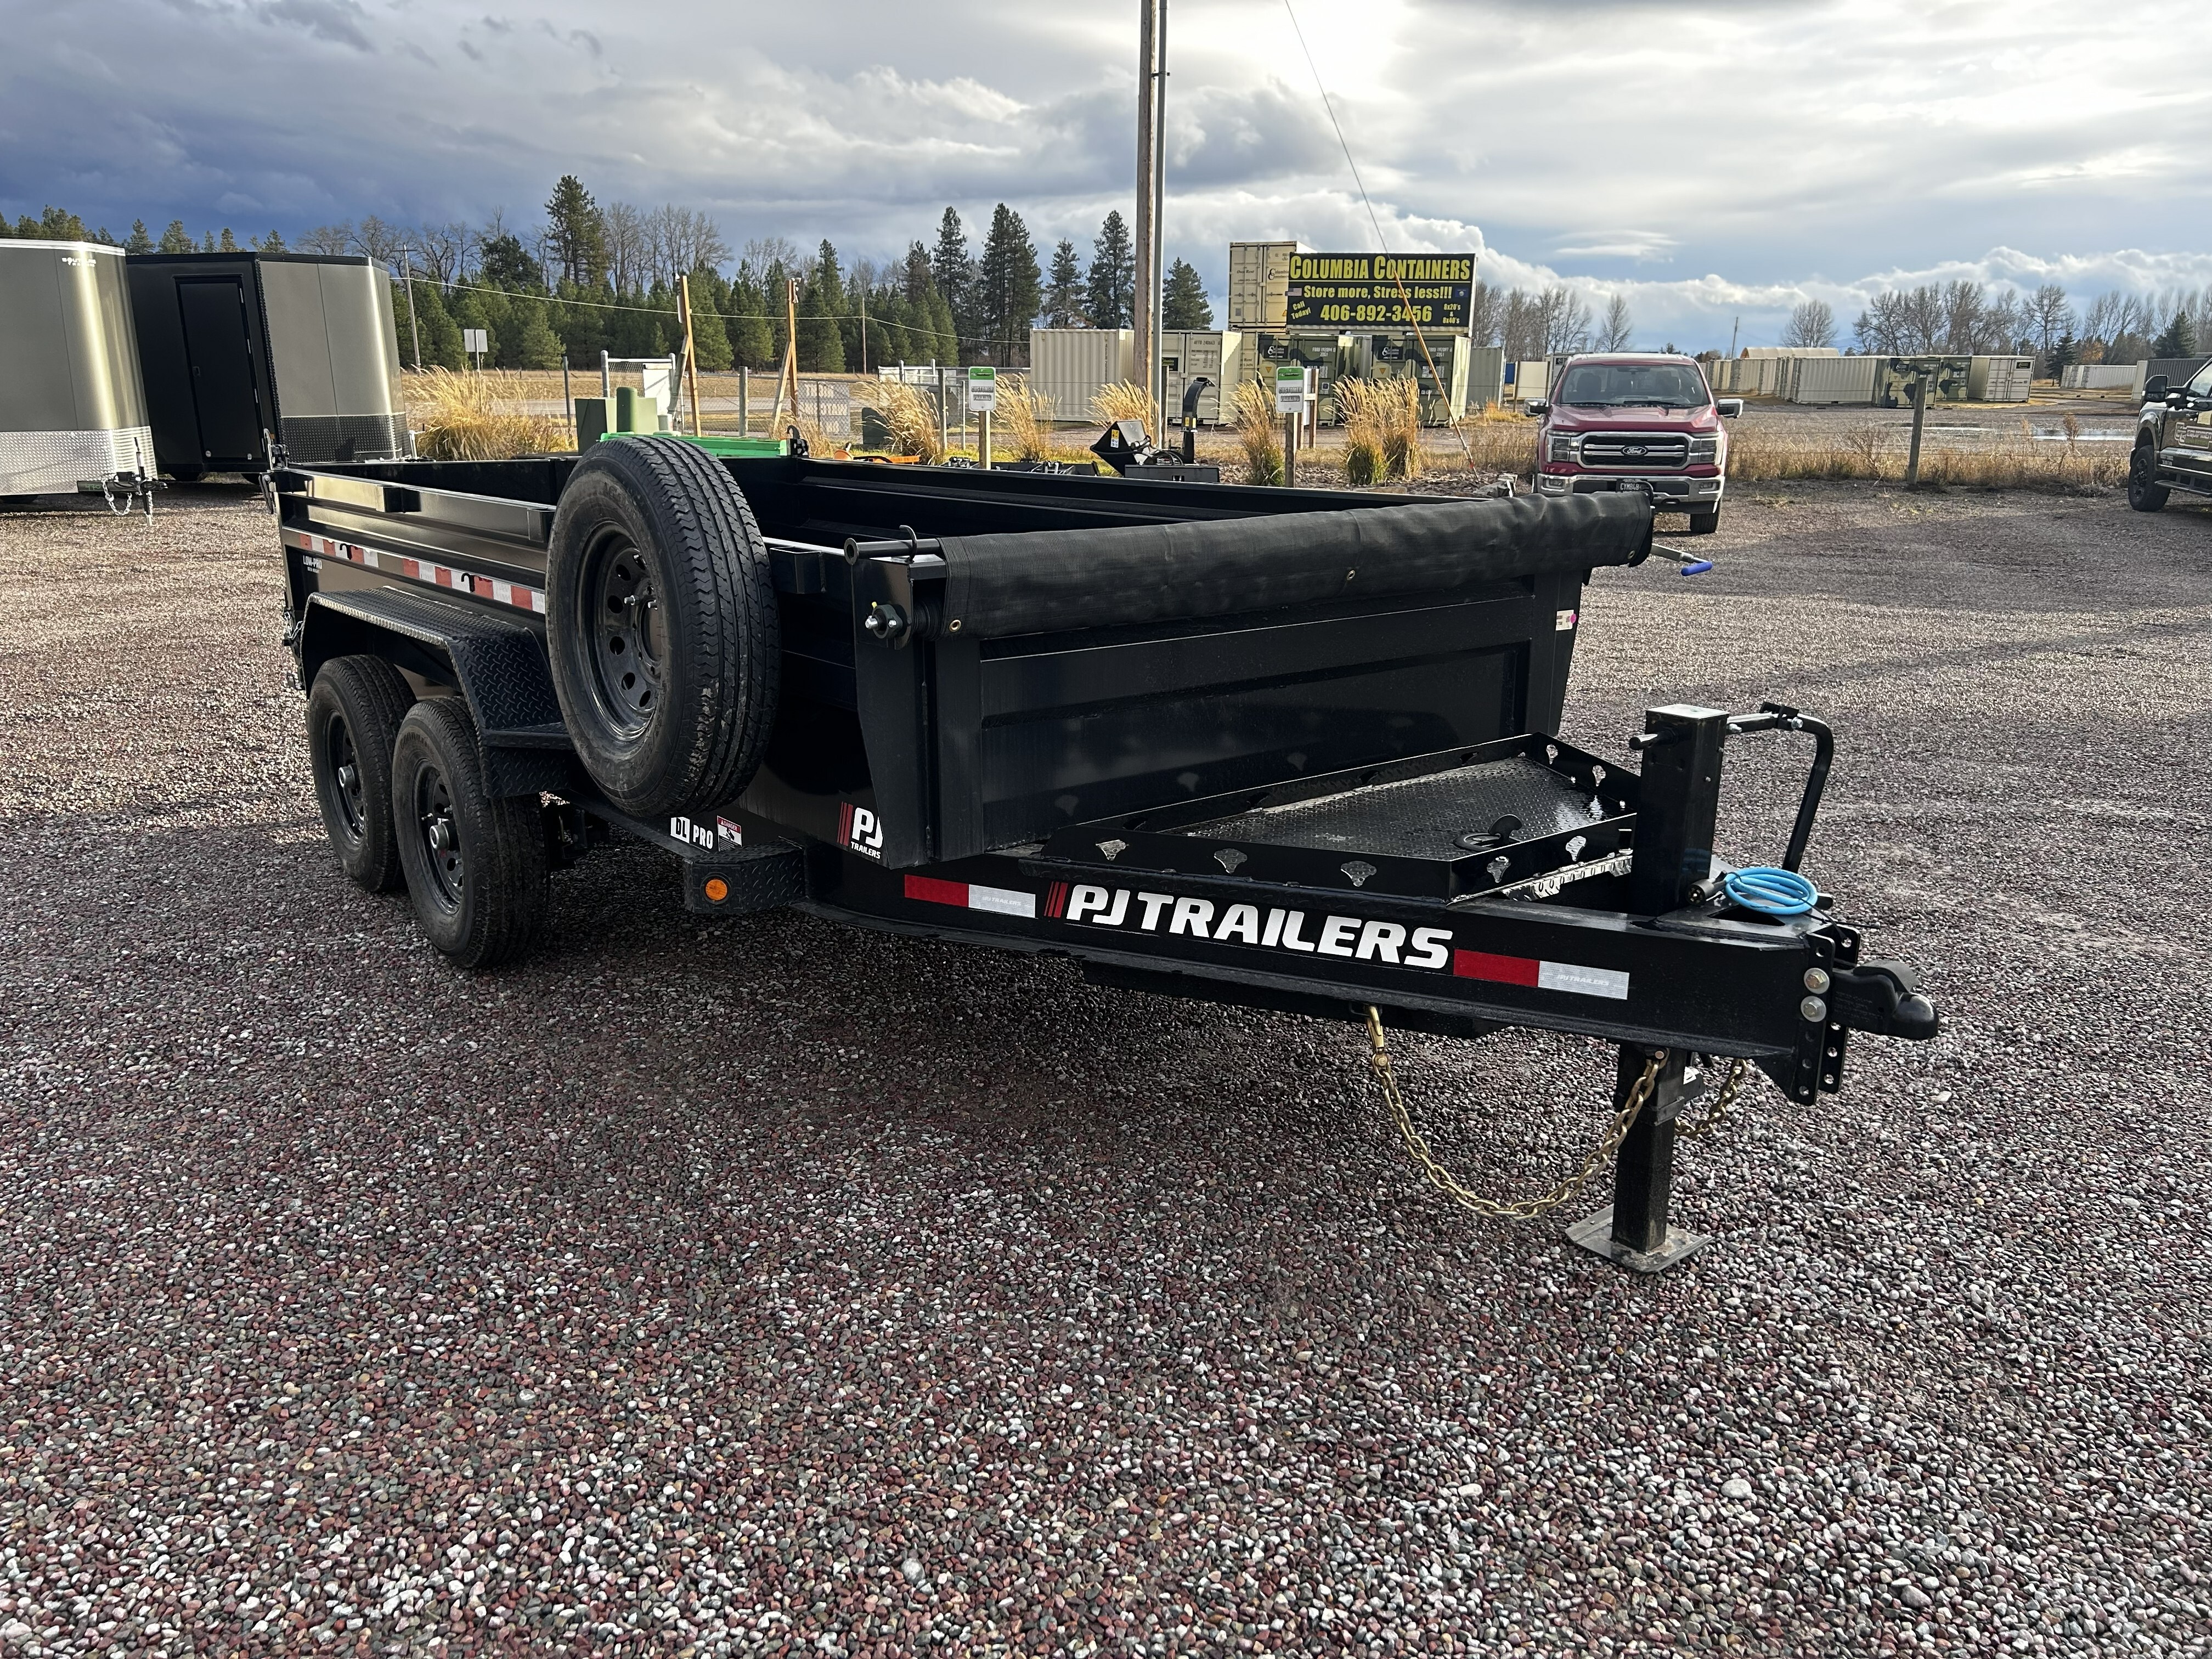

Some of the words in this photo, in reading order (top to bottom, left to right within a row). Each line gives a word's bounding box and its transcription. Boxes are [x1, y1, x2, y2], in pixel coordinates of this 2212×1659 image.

[1290, 256, 1369, 279] COLUMBIA
[1374, 256, 1470, 280] CONTAINERS
[1304, 285, 1336, 298] Store
[1338, 287, 1371, 299] more,
[1374, 286, 1412, 298] Stress
[1414, 286, 1452, 299] less!!!
[1291, 307, 1311, 319] Today!
[1293, 301, 1305, 310] Call
[1320, 304, 1433, 322] 406-892-3456
[303, 555, 323, 569] LOW-PRO
[692, 824, 713, 849] PRO
[852, 808, 883, 848] PJ
[851, 841, 881, 859] TRAILERS
